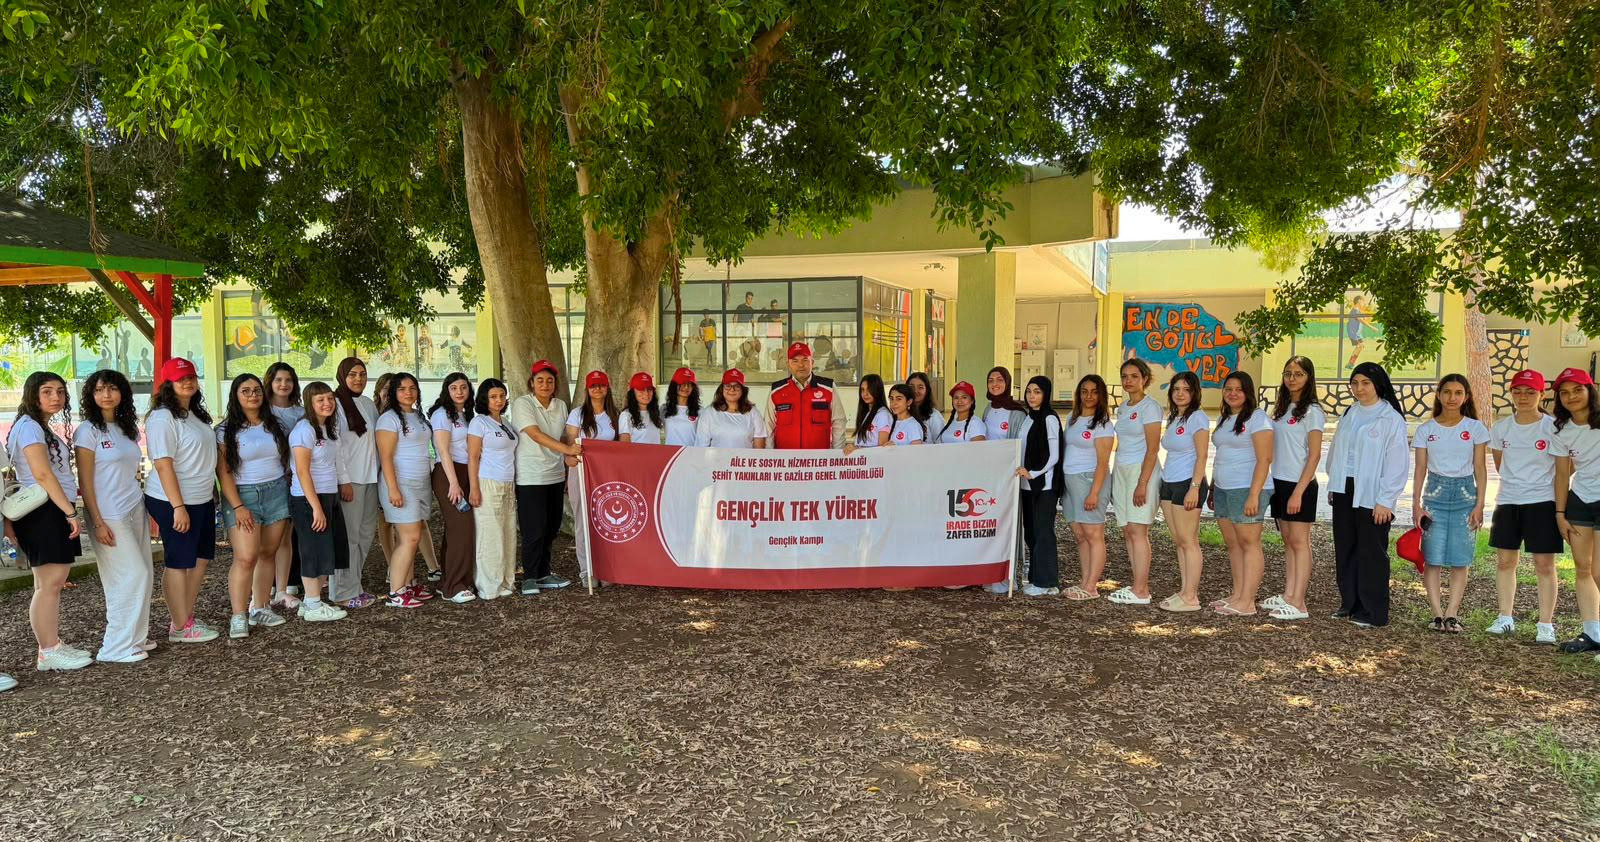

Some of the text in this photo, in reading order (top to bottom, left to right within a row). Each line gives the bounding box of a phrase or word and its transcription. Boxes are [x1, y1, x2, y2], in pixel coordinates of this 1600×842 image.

[1123, 306, 1199, 331] EN DE
[1185, 354, 1231, 383] VER
[730, 455, 867, 468] AİLE VE SOSYAL HİZMETLER BAKANLIĞI
[712, 467, 884, 483] ŞEHİT YAKINLARI VE GAZİLER GENEL MÜDÜRLÜĞÜ
[716, 495, 877, 528] GENÇLİK TEK YÜREK
[946, 518, 997, 530] İRADE BİZİM
[946, 528, 996, 540] ZAFER BİZİM
[768, 535, 824, 548] Gençlik Kampı
